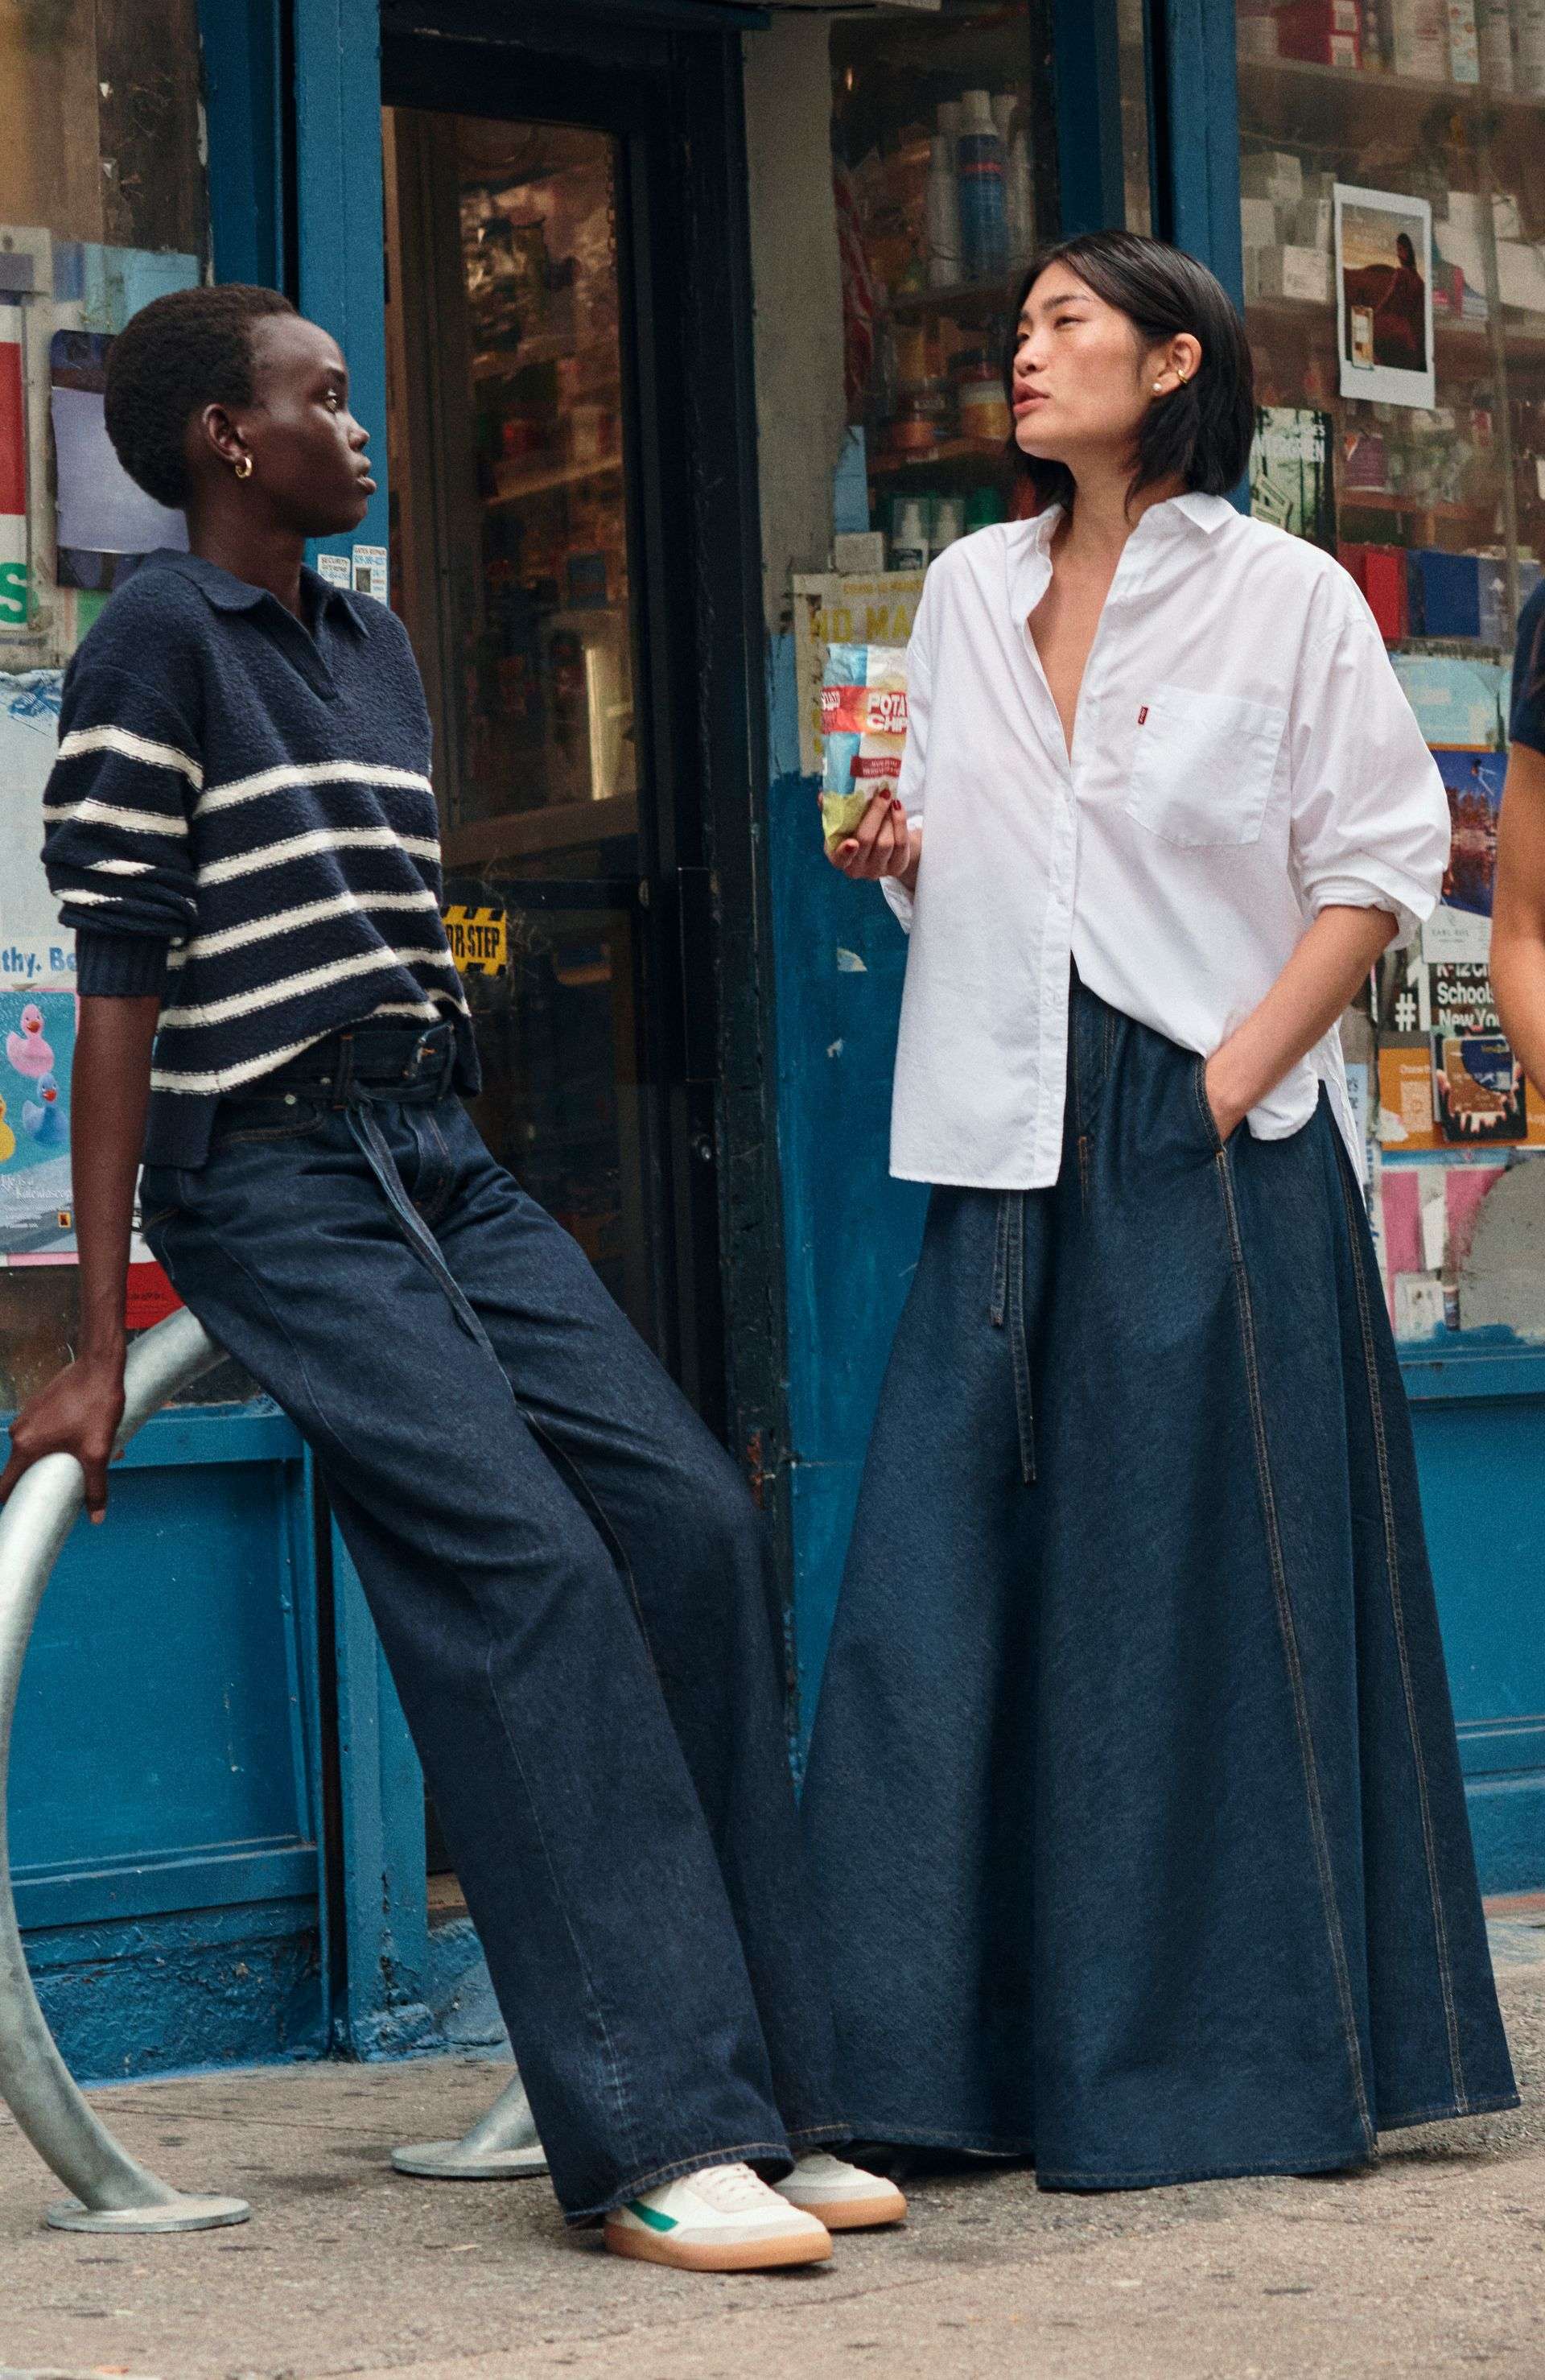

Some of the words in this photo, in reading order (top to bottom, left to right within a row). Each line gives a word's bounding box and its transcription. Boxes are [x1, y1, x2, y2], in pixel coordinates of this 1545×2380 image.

[865, 604, 915, 641] MA
[867, 693, 908, 716] POTA
[468, 925, 500, 958] STEP
[1437, 980, 1494, 1004] School
